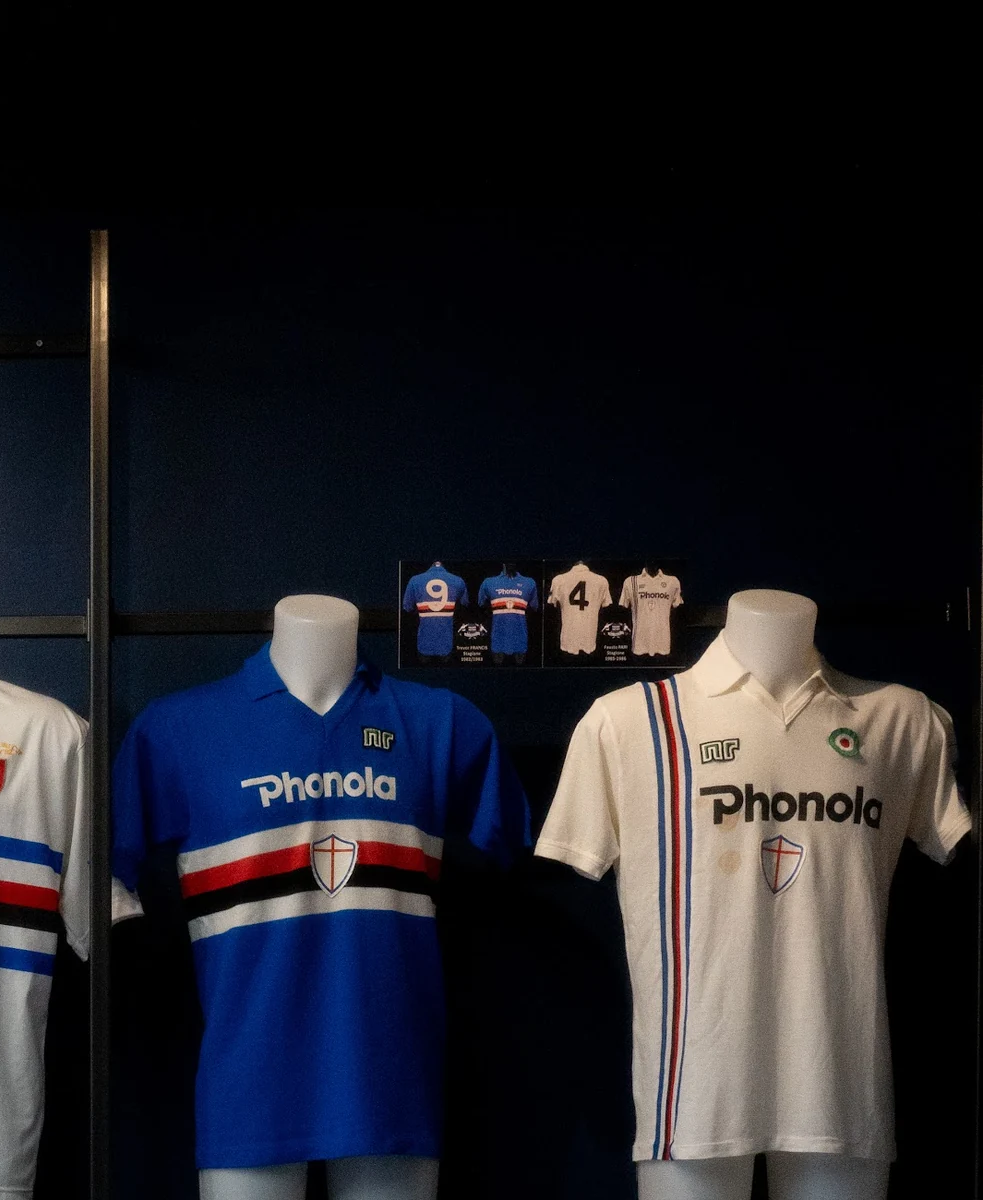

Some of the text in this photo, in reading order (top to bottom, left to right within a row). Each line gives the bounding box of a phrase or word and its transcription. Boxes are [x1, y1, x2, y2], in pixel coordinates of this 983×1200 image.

[425, 579, 449, 612] 9
[569, 580, 589, 611] 4
[241, 766, 397, 808] Phonola
[700, 783, 883, 829] Phonola
